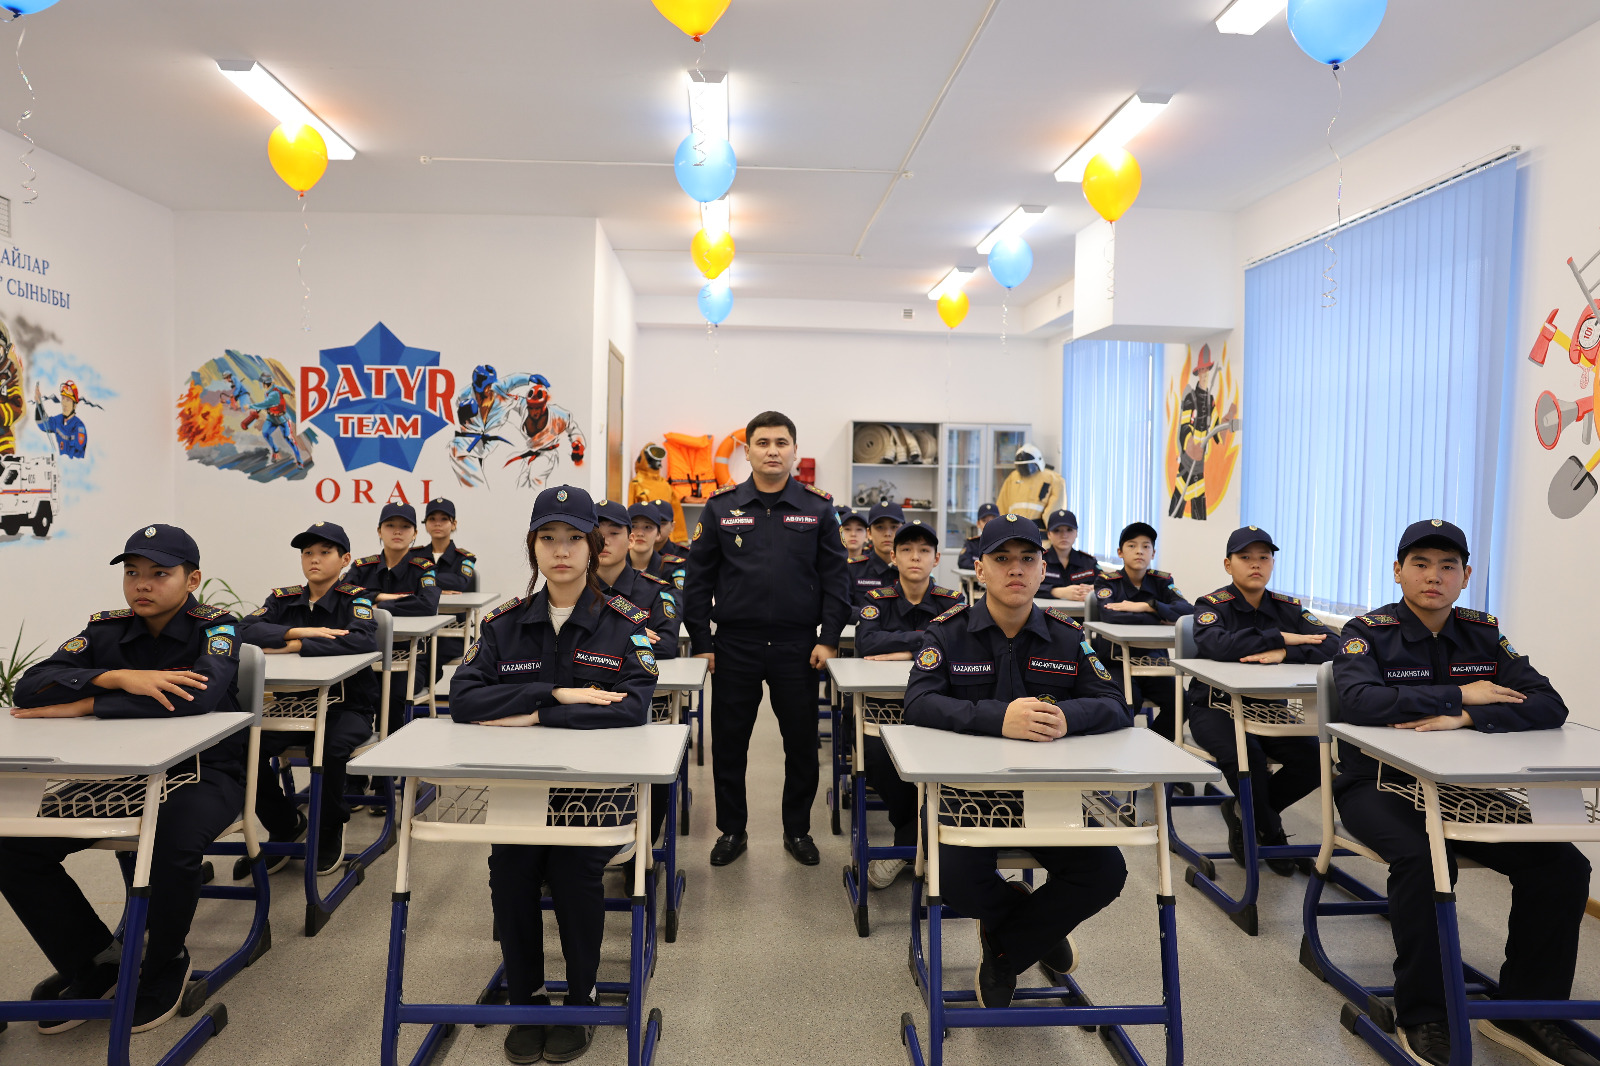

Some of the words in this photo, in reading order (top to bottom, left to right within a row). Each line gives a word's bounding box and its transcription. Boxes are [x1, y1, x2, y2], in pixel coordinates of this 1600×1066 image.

[7, 278, 70, 310] СЫНЫБЫ
[298, 365, 456, 428] BATYR
[336, 414, 420, 438] TEAM
[952, 664, 991, 672] KAZAKHSTAN
[1387, 670, 1430, 678] KAZAKHSTAN
